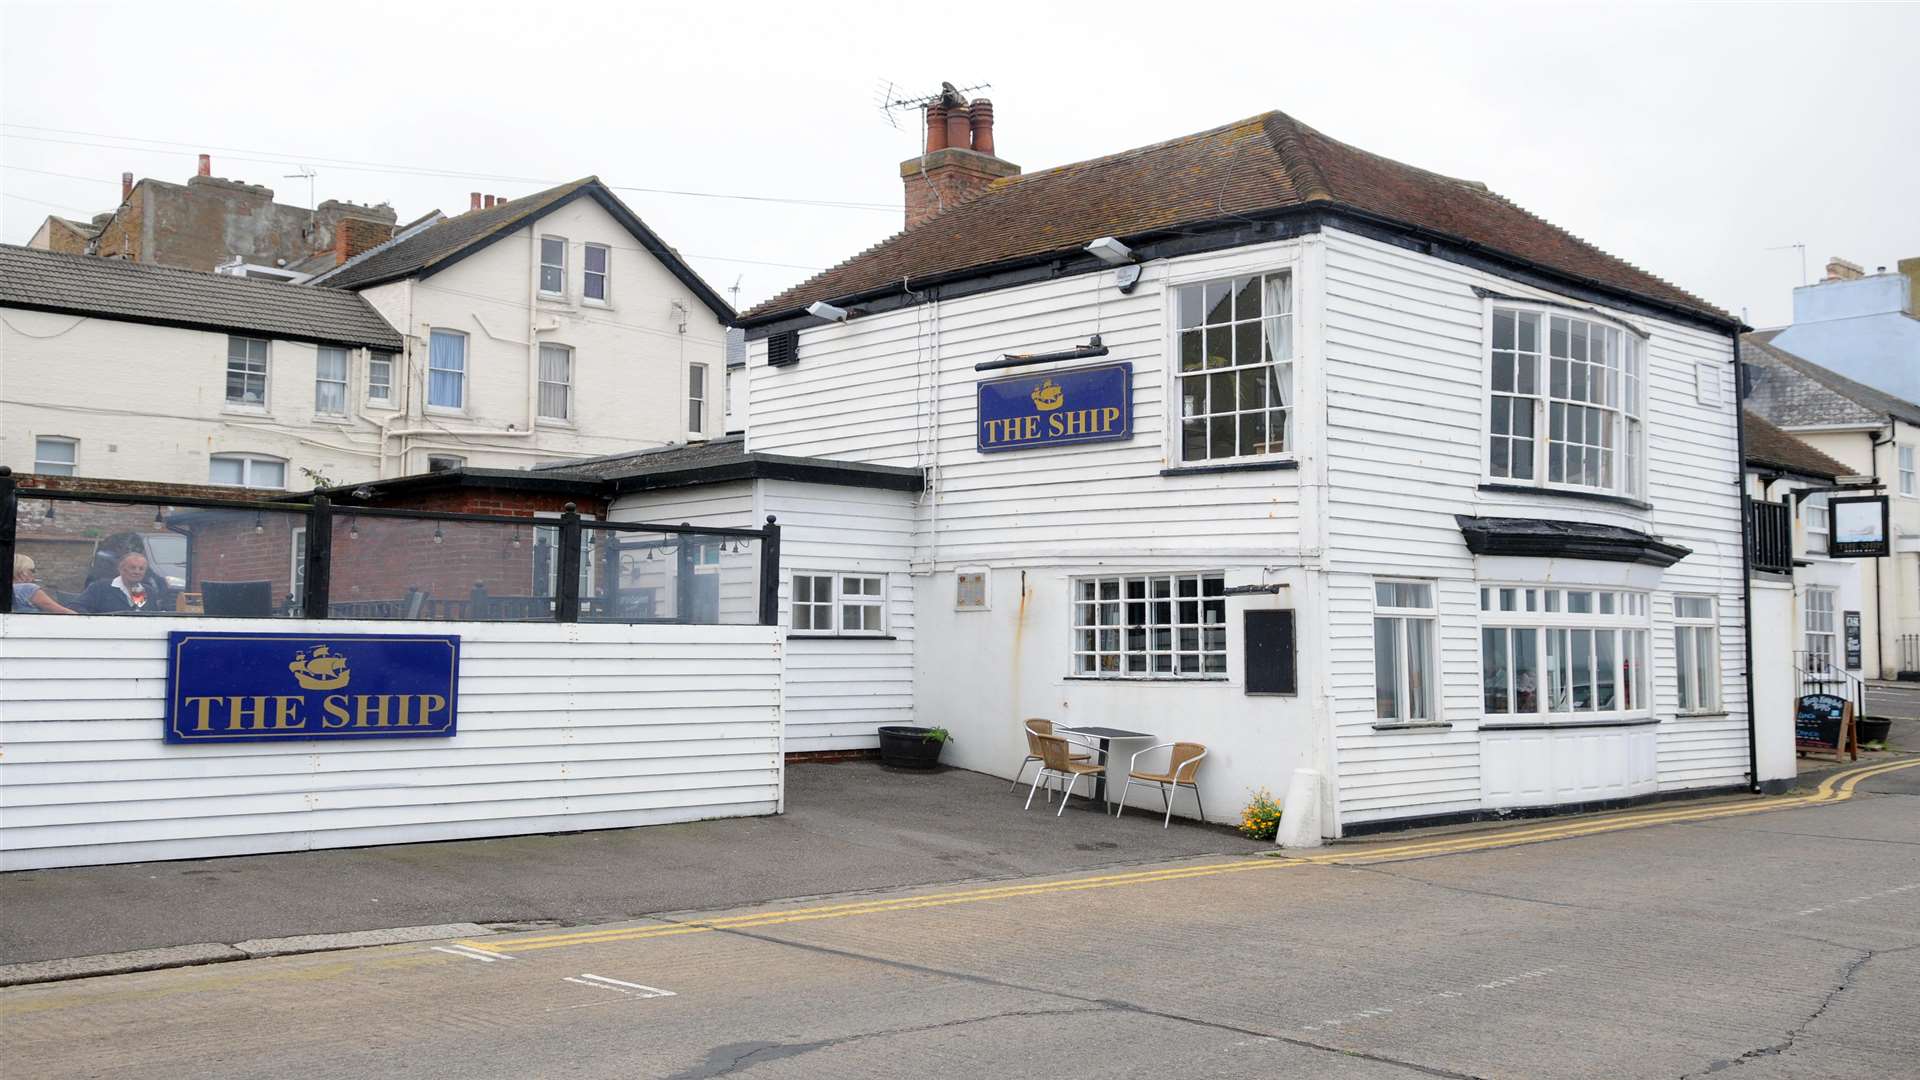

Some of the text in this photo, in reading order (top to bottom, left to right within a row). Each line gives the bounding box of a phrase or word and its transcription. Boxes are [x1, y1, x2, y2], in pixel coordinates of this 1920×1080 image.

[984, 407, 1120, 443] THE SHIP
[185, 694, 446, 731] THE SHIP
